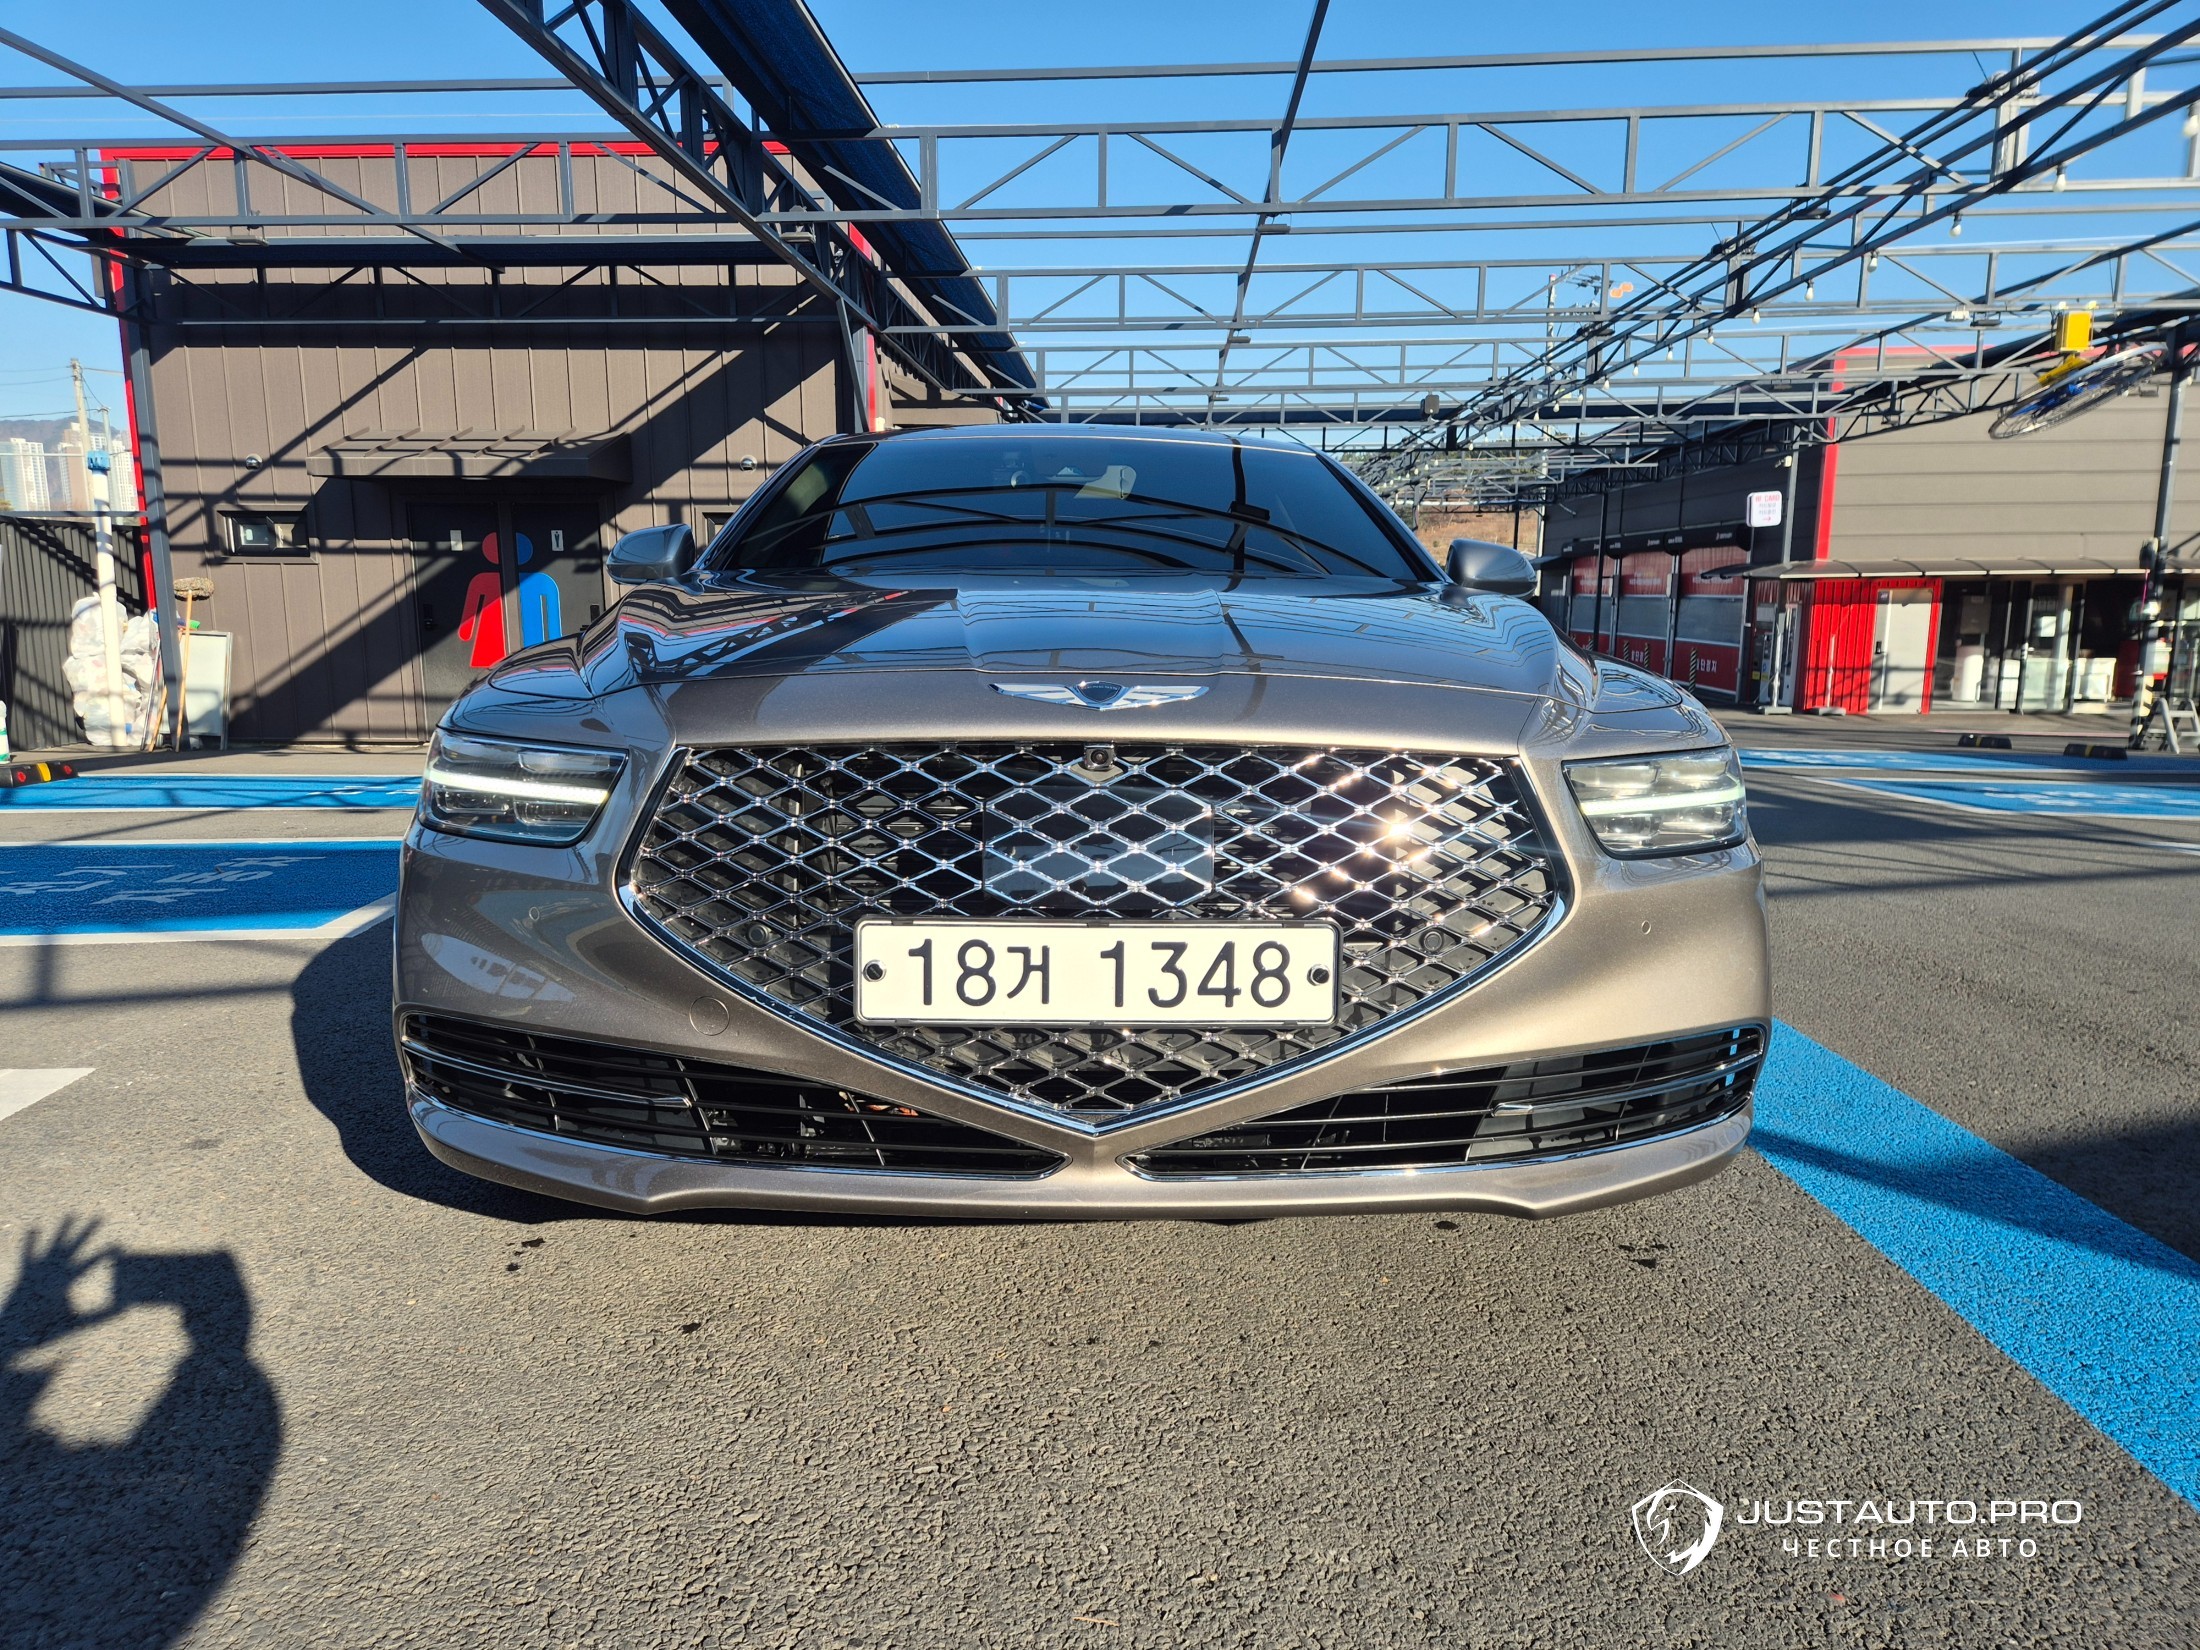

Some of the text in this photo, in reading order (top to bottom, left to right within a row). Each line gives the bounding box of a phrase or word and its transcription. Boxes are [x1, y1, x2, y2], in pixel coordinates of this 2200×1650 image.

[90, 855, 327, 905] 자동차
[907, 938, 1292, 1009] 18거 1348
